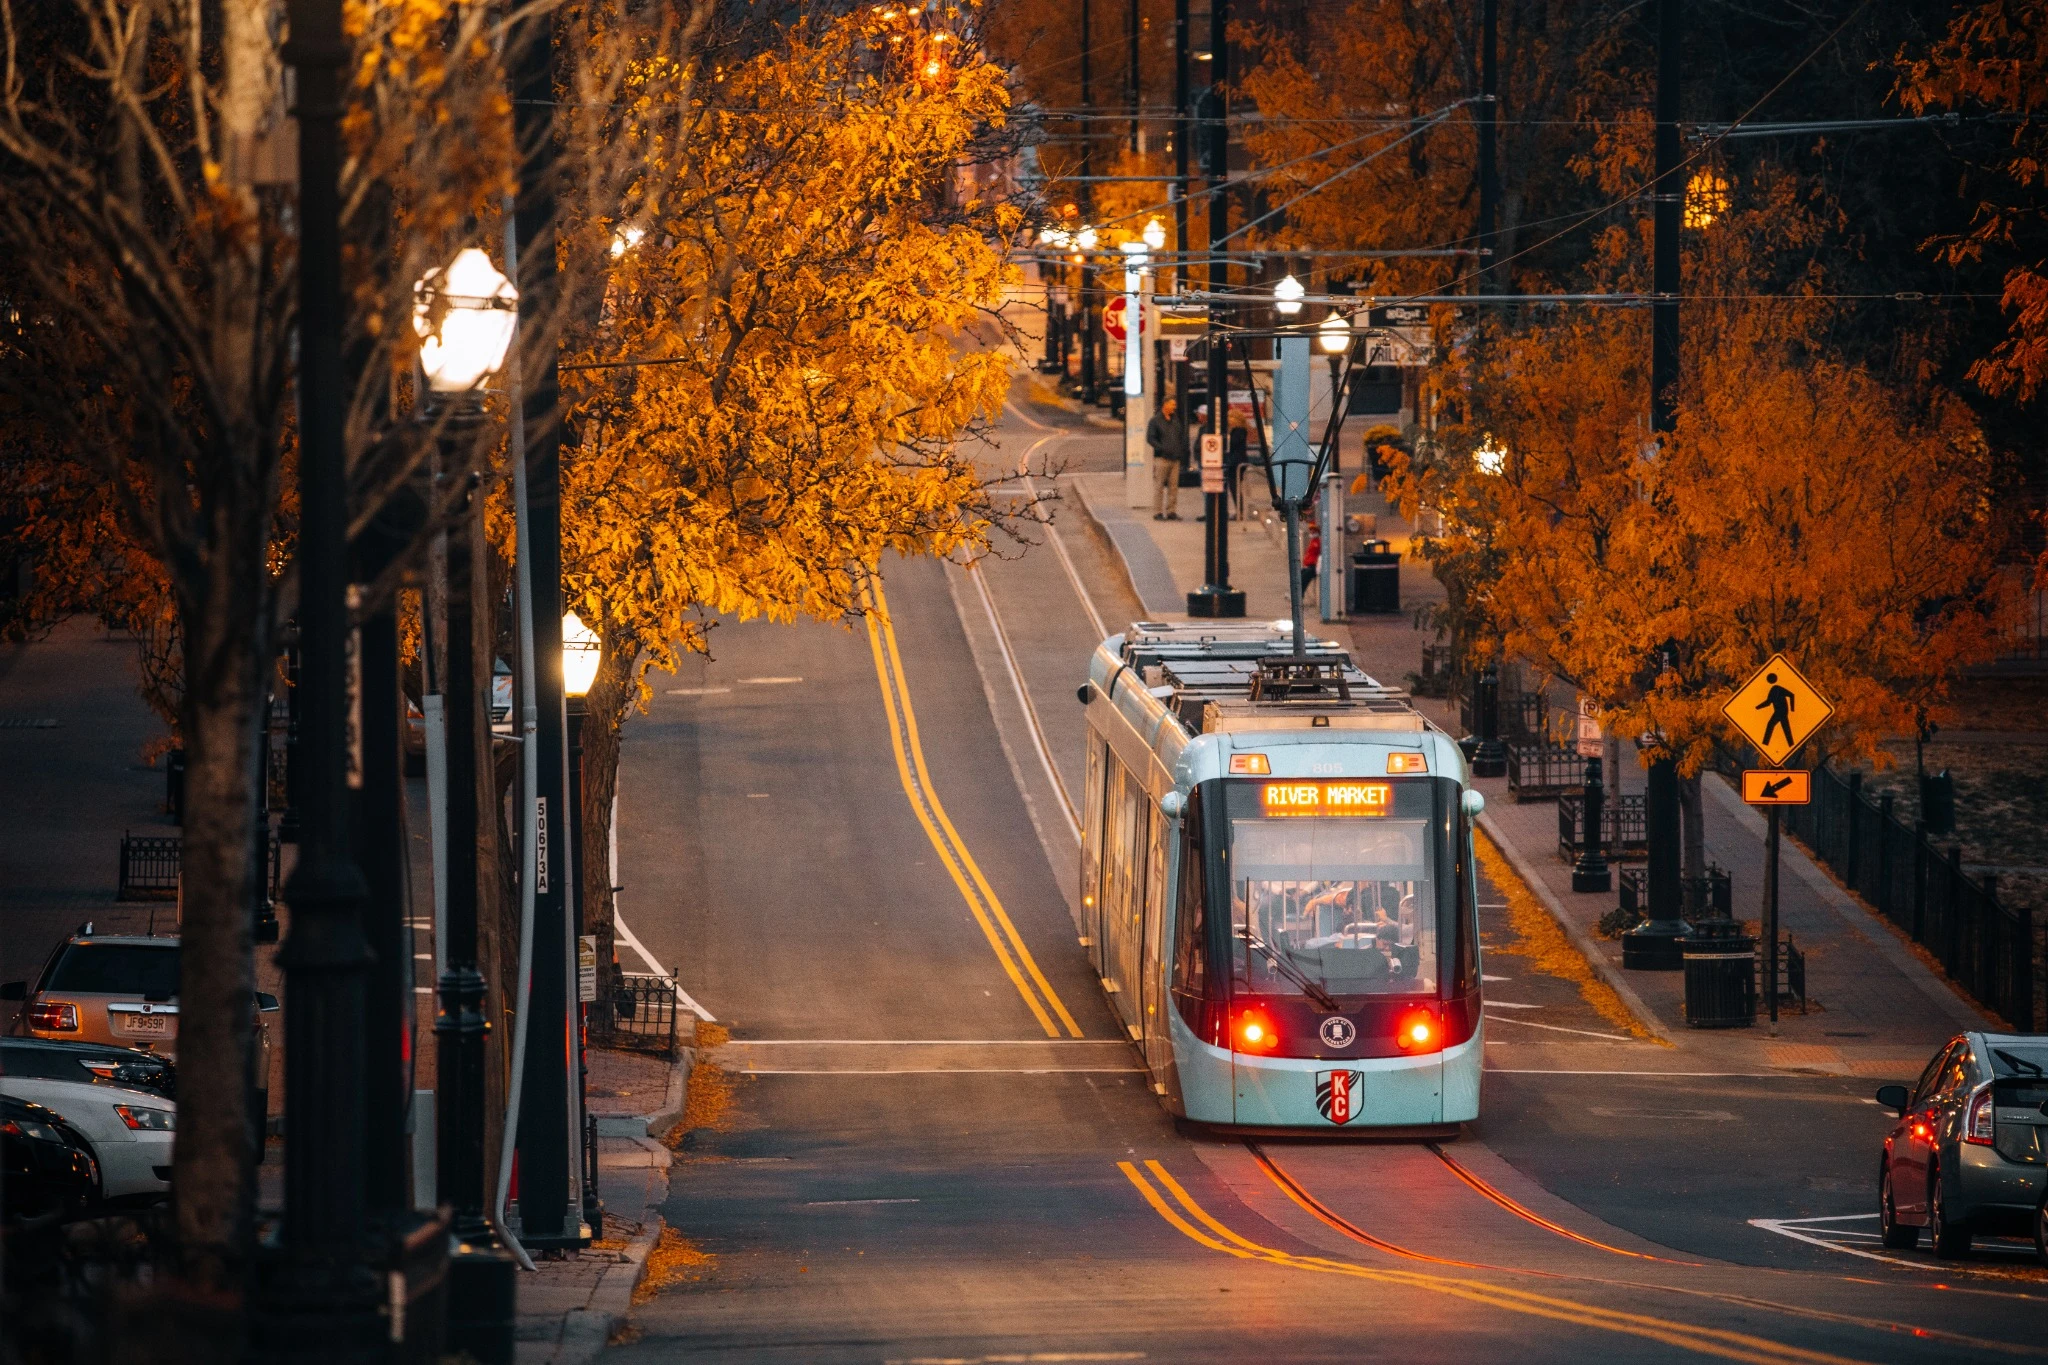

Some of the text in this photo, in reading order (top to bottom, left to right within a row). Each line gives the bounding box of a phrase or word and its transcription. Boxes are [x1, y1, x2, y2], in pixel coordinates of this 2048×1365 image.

[1106, 310, 1145, 328] ST
[1312, 762, 1344, 774] 805
[1267, 786, 1388, 805] RIVER MARKET
[537, 803, 547, 889] 50673A
[1334, 1075, 1346, 1117] KC
